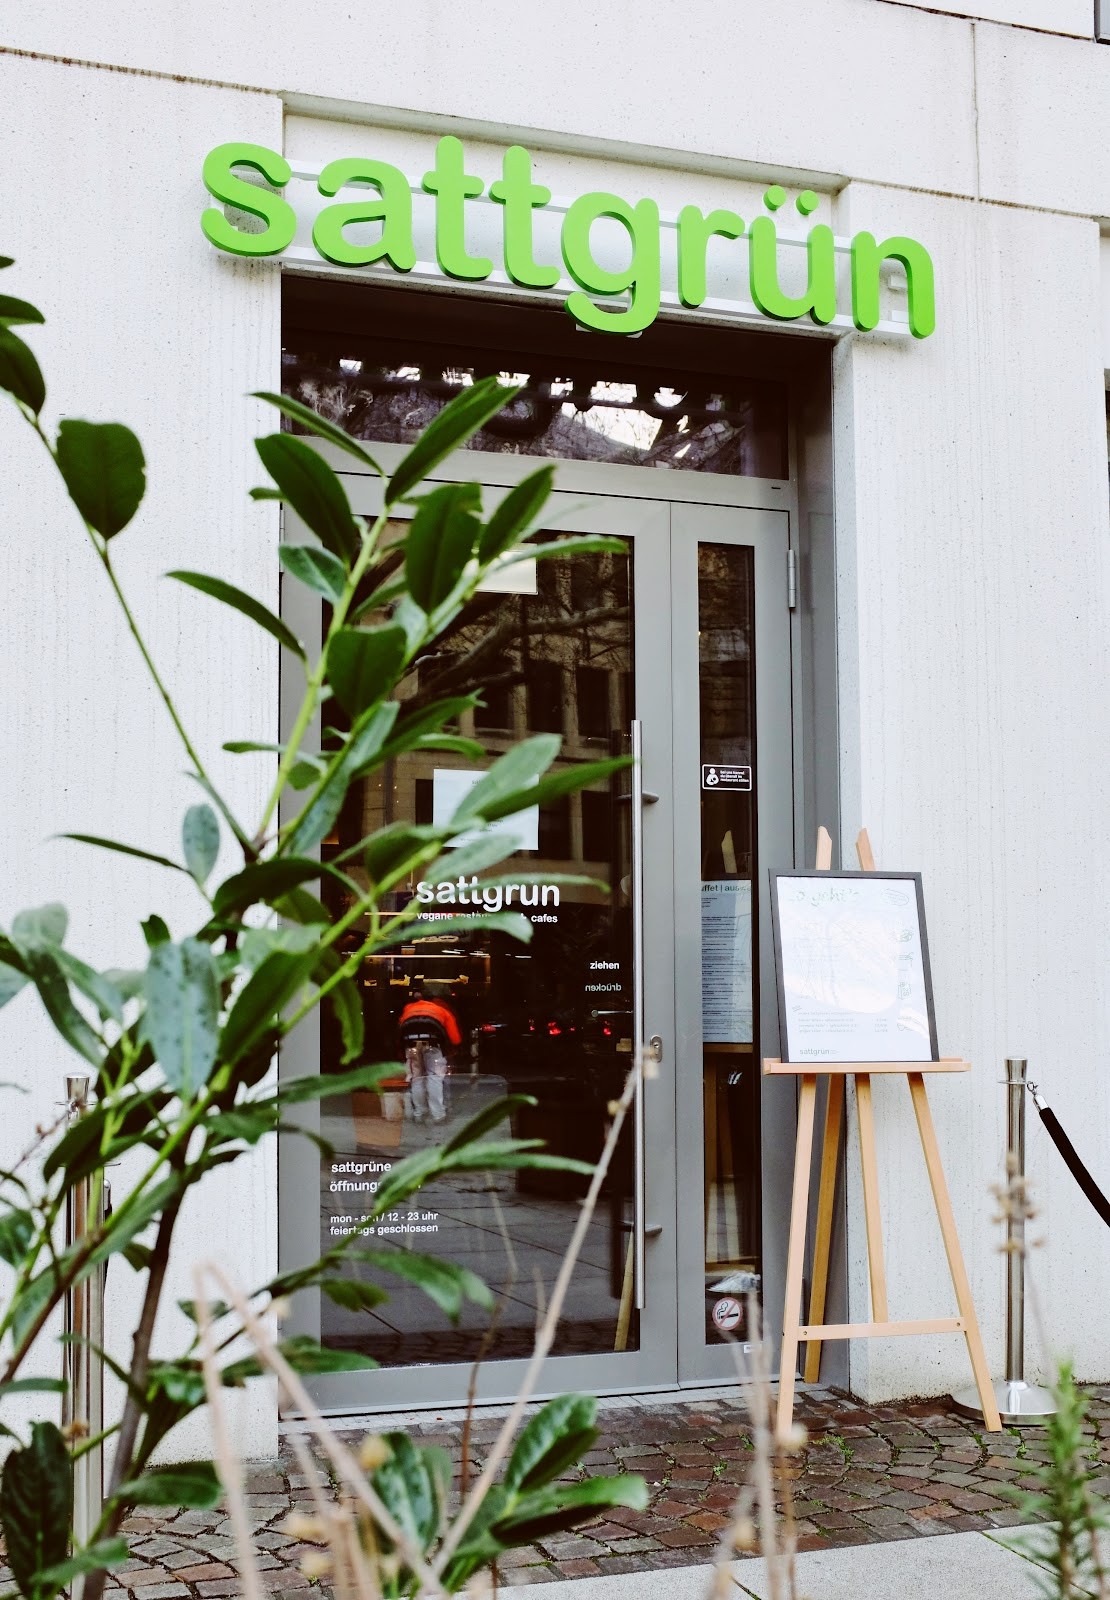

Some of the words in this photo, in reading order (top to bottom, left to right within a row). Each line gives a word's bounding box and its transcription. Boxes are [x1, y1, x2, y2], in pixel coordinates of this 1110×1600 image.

[200, 135, 936, 339] sattgrün
[416, 912, 453, 921] vegane
[530, 913, 558, 923] cafes
[589, 960, 620, 970] ziehen
[331, 1161, 392, 1175] sattgrüne
[330, 1215, 352, 1223] mon
[387, 1212, 399, 1222] 12
[407, 1211, 420, 1221] 23
[421, 1211, 438, 1221] uhr
[377, 1223, 438, 1236] geschlossen
